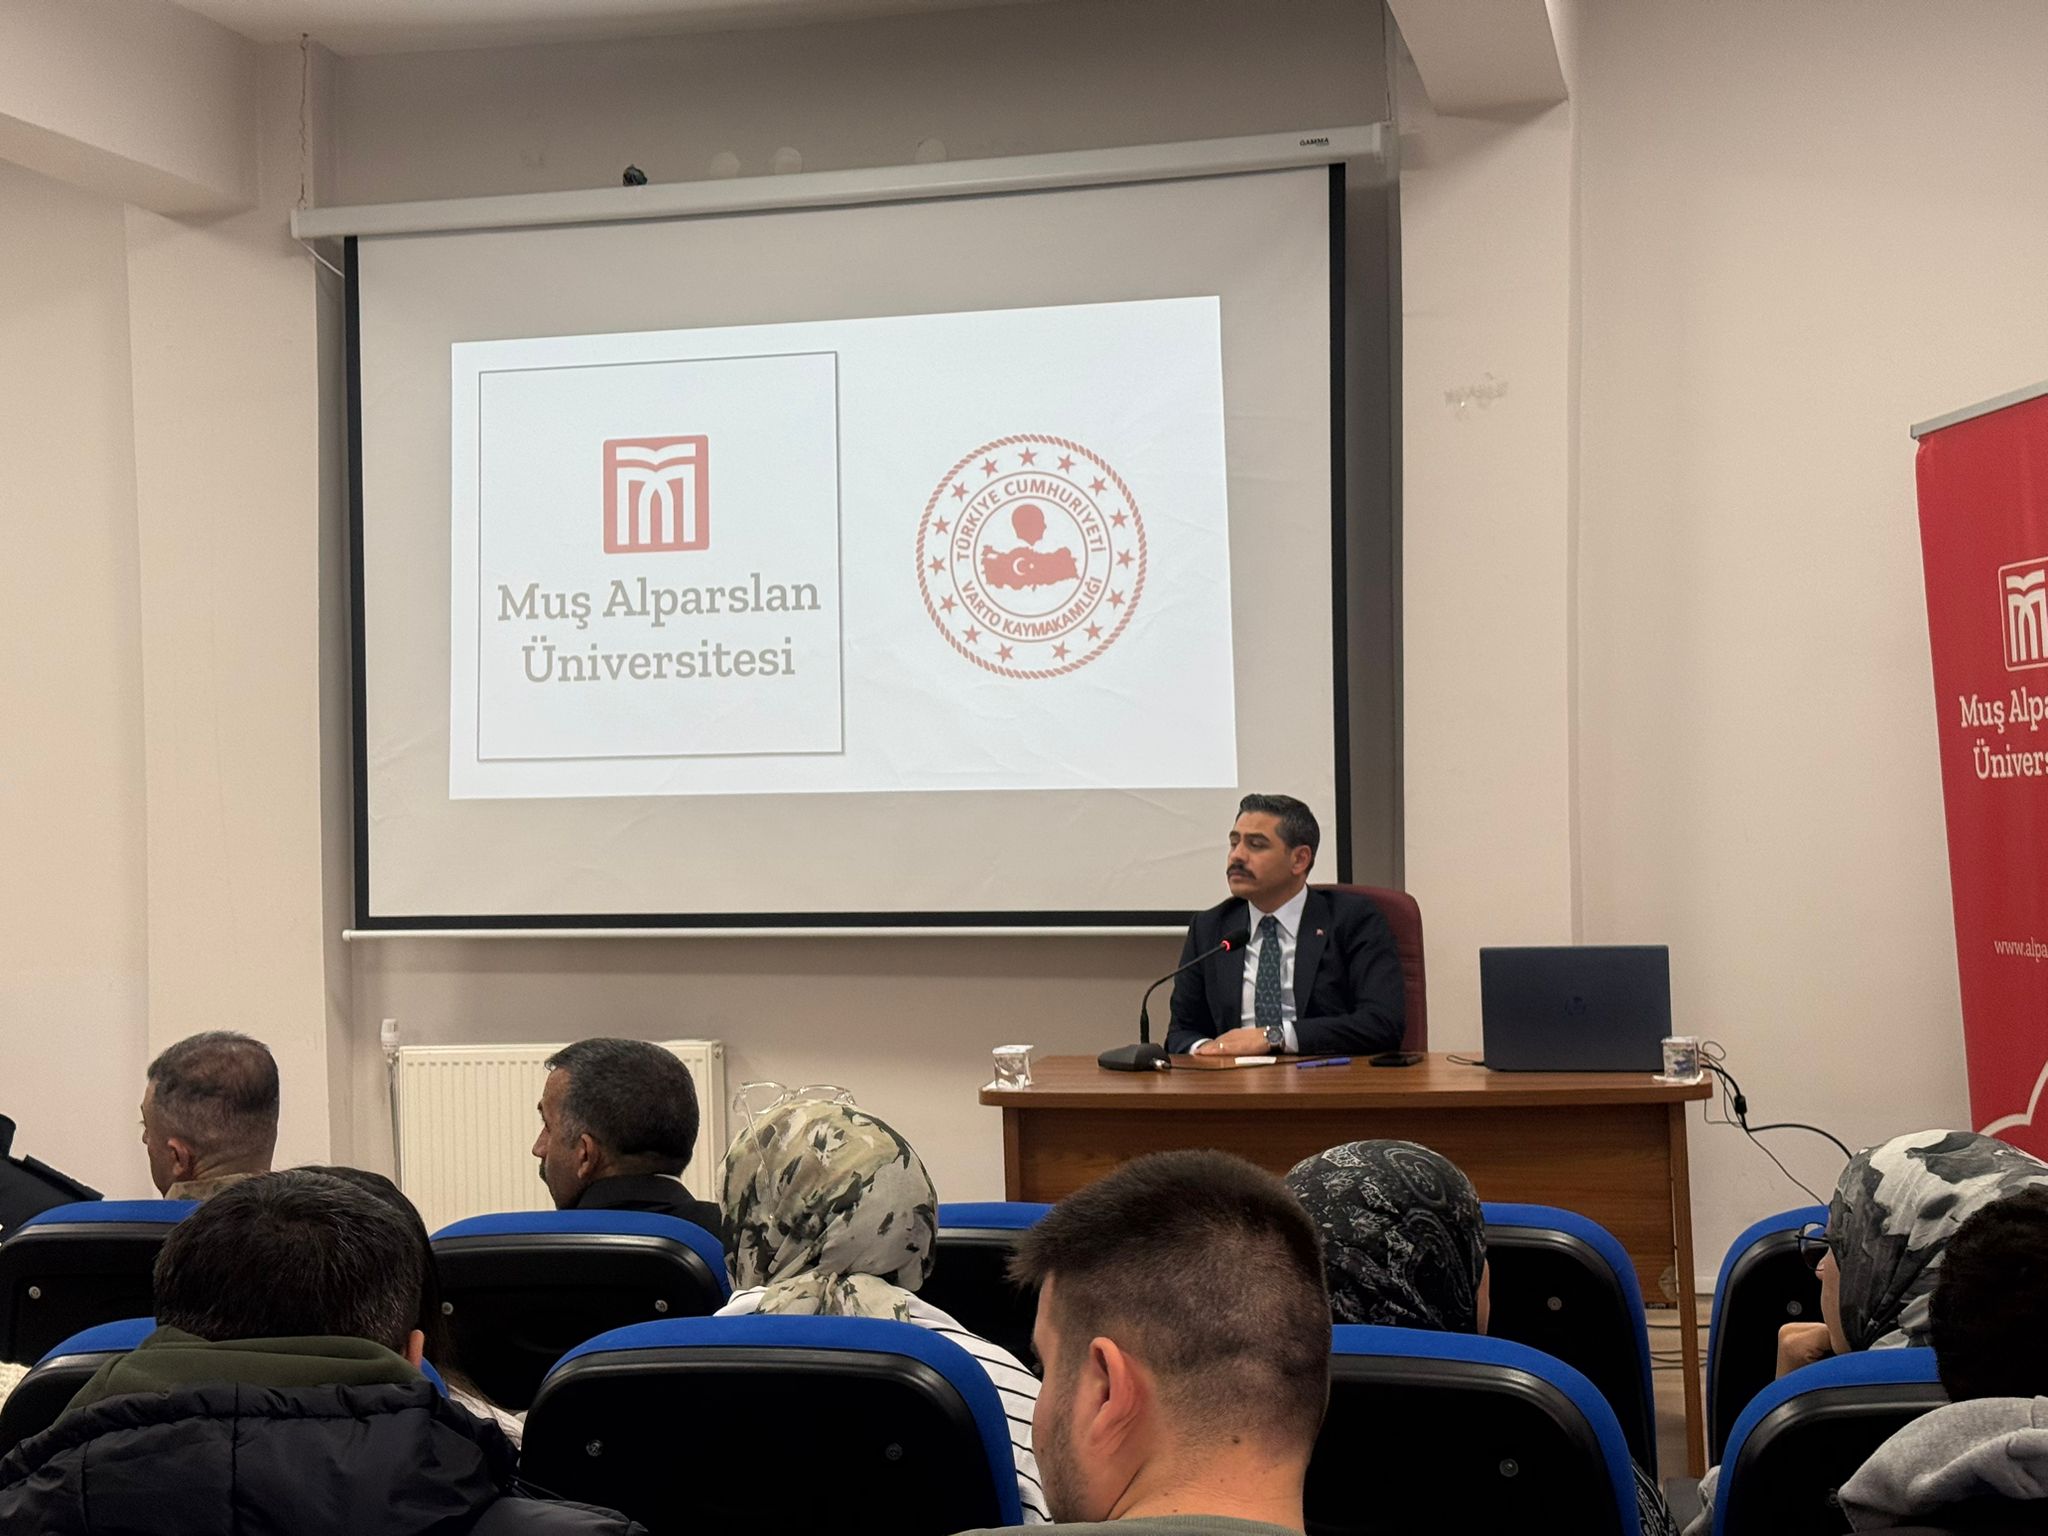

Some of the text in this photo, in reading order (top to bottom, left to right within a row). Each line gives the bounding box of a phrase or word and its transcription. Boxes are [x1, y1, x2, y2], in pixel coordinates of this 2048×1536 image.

[955, 479, 1106, 562] TÜRKİYE CUMHURİYETİ
[498, 573, 821, 629] Muş Alparslan
[961, 576, 1102, 637] VARTO KAYMAKAMLIĞI
[522, 635, 796, 682] Üniversitesi
[1959, 694, 2005, 734] Muş
